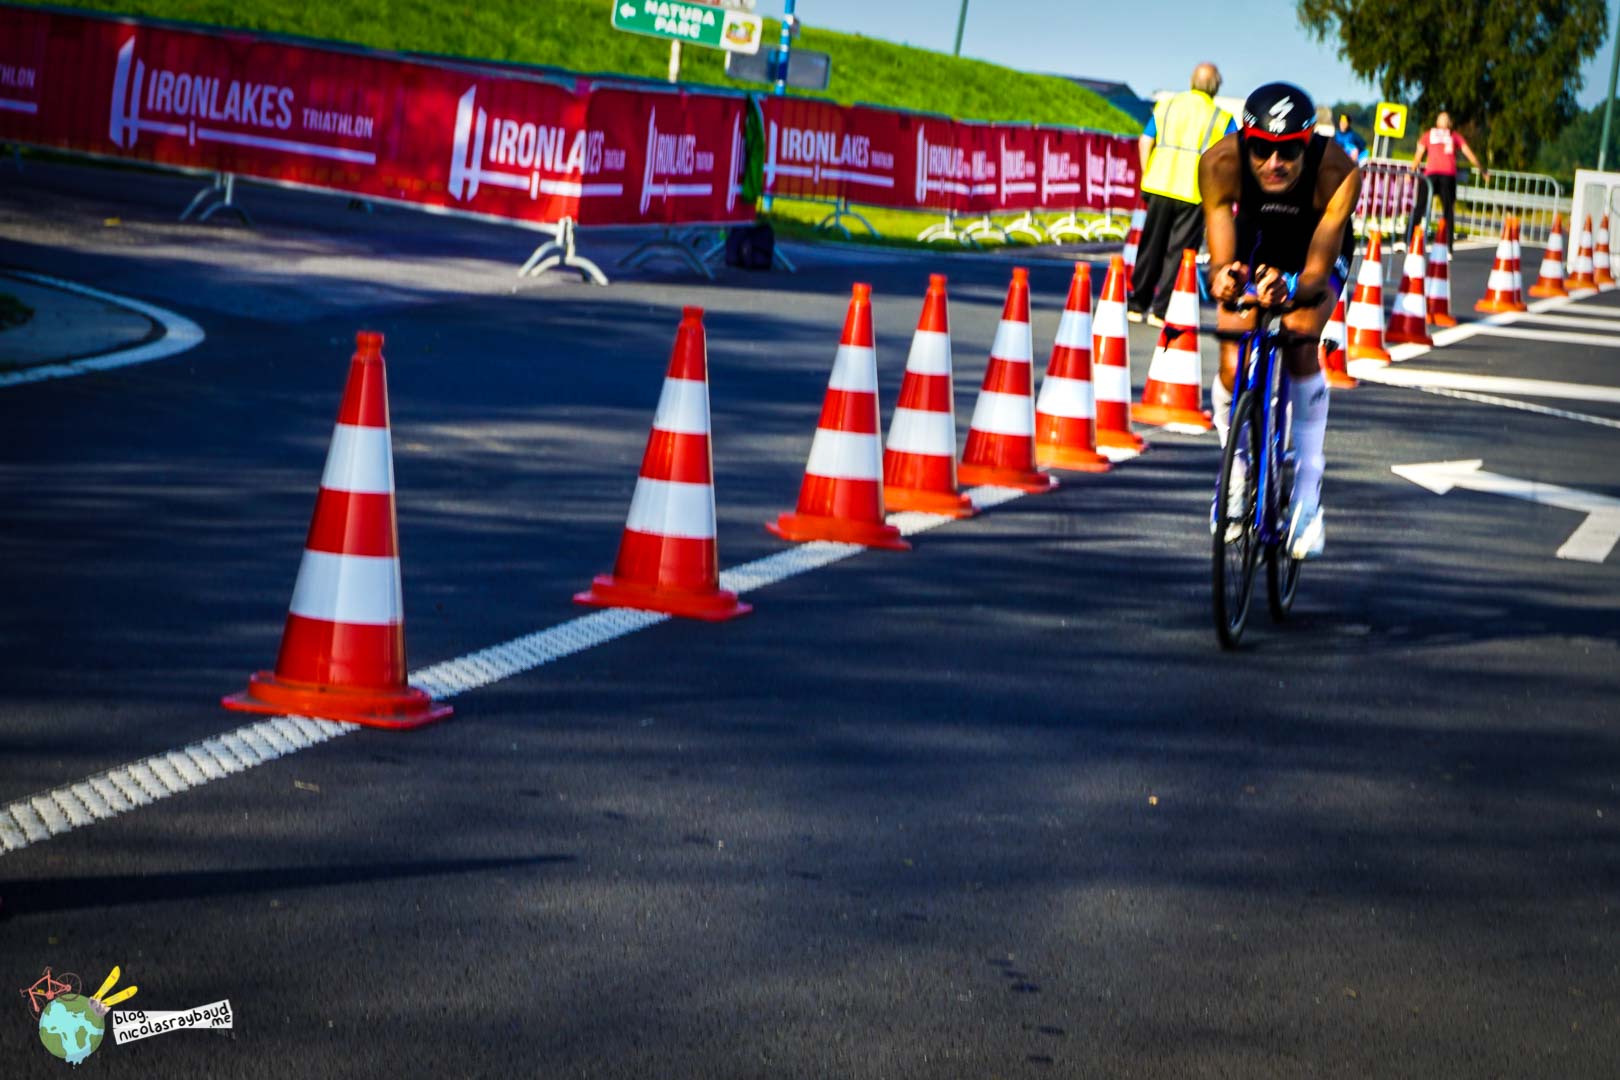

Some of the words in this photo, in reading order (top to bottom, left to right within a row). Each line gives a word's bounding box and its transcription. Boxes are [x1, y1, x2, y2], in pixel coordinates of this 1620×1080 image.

[644, 0, 715, 26] NATURA
[654, 16, 700, 39] PARC
[147, 69, 294, 130] IRONLAKES
[302, 107, 374, 139] TRIATHLON
[781, 127, 870, 169] IRONLAKES
